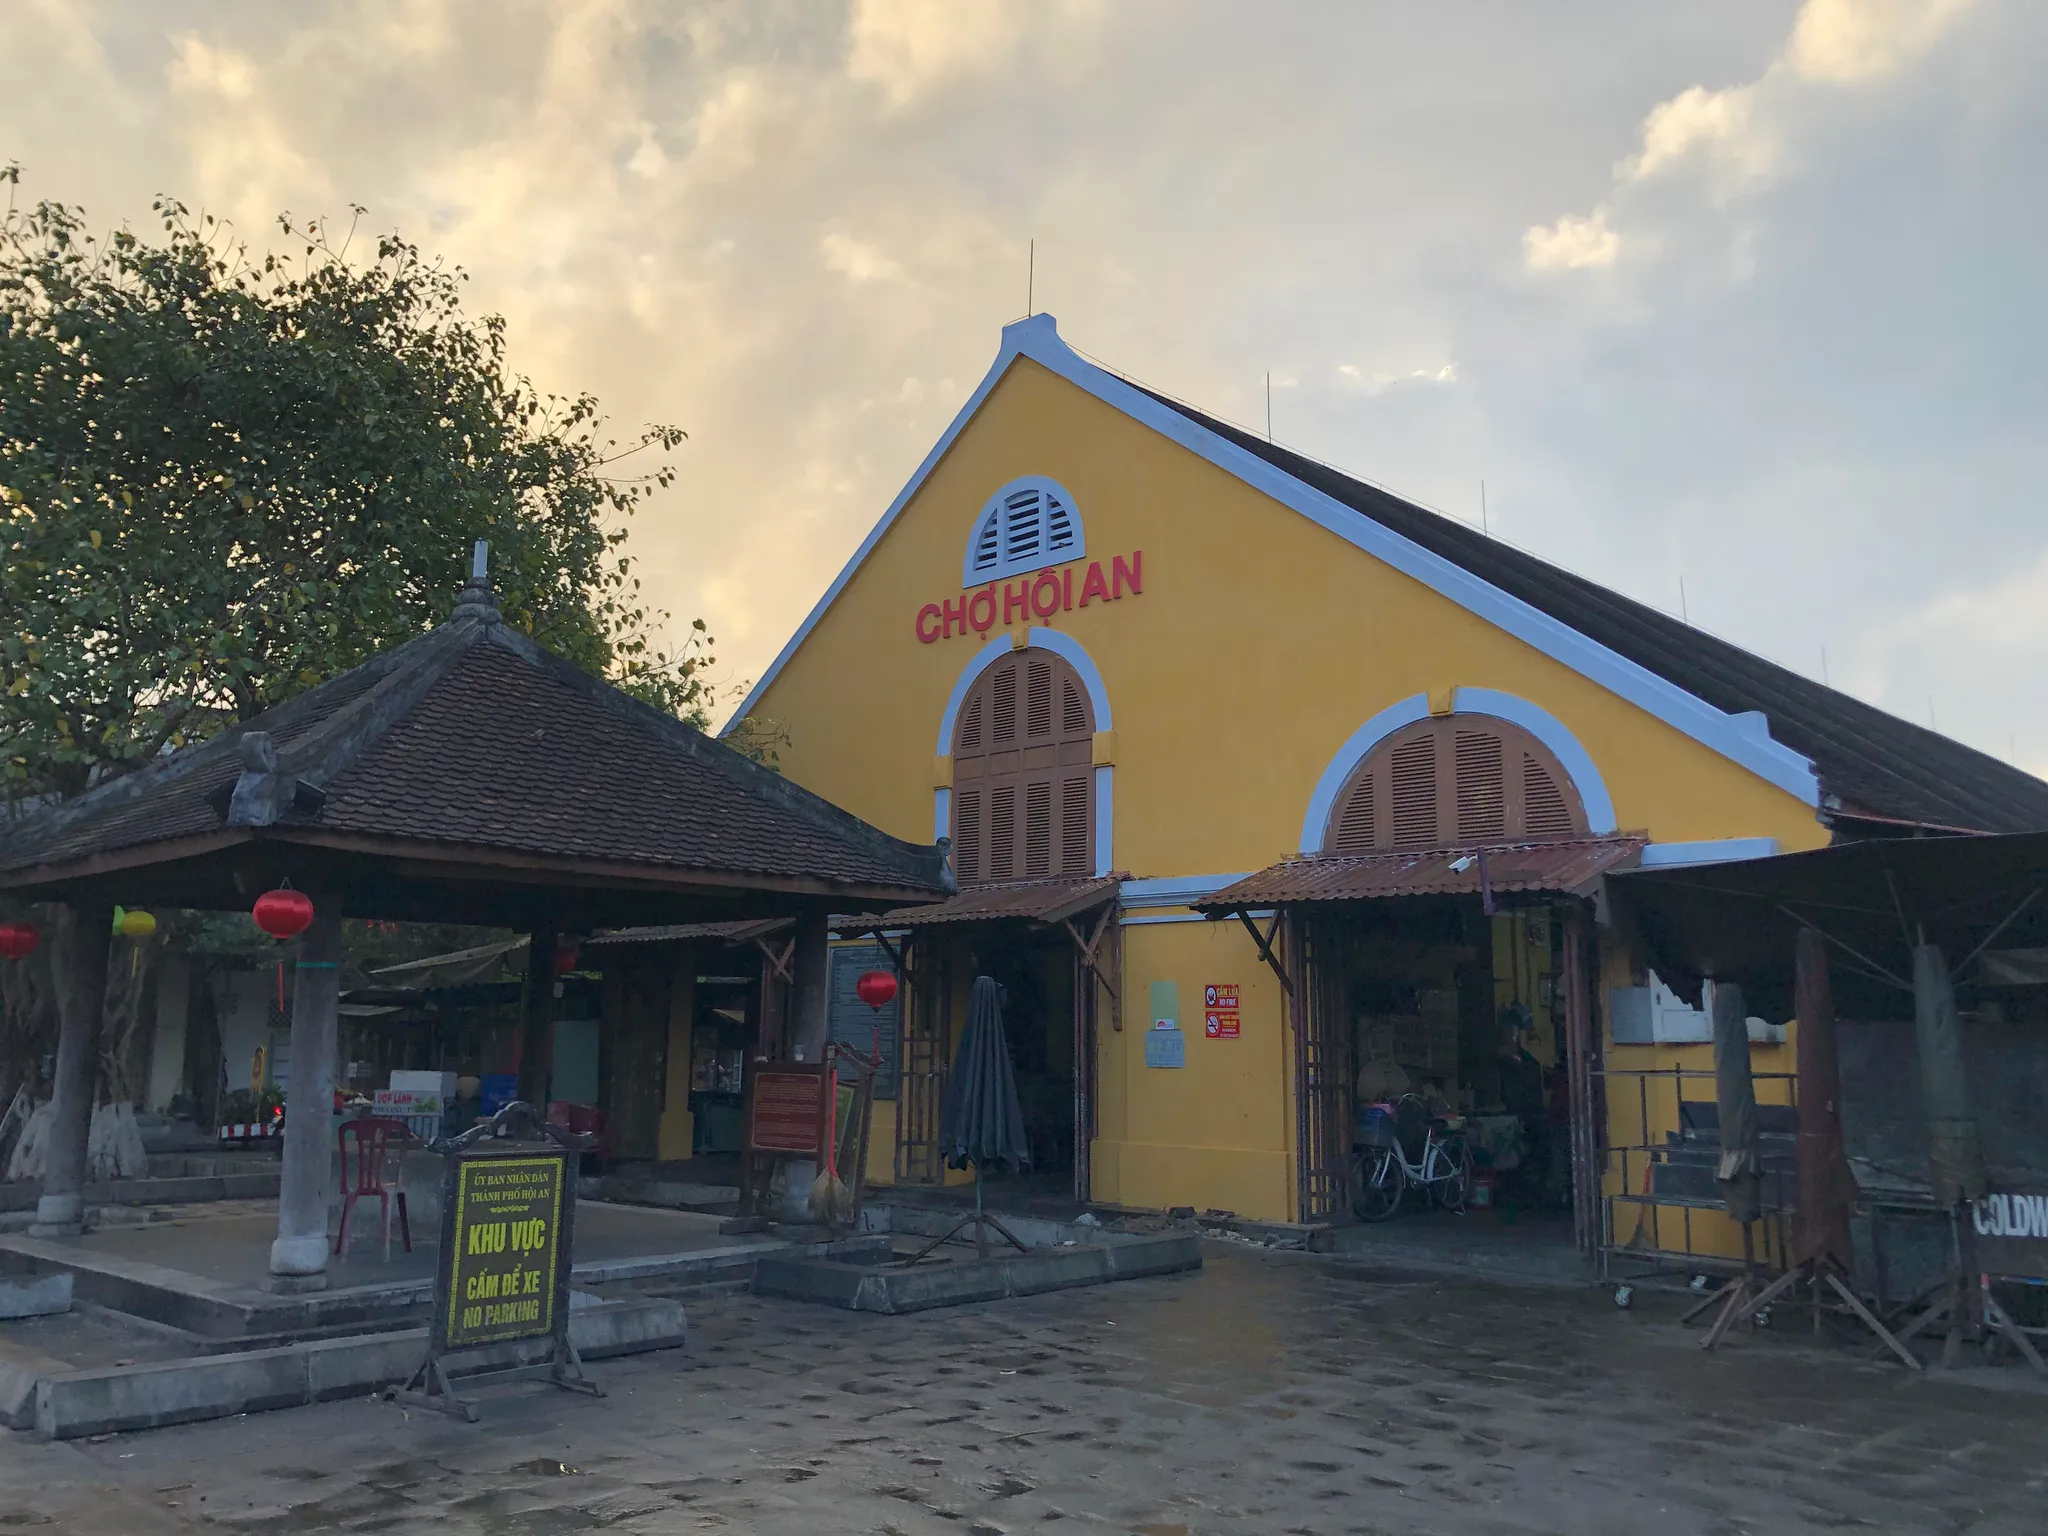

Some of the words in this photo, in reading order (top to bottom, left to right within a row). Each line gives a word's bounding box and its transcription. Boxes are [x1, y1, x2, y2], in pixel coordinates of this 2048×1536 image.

[915, 582, 997, 643] CHỢ
[1003, 566, 1073, 626] HỘI
[1079, 550, 1142, 608] AN
[487, 1174, 507, 1185] BAN
[507, 1171, 532, 1184] NHÂN
[532, 1170, 549, 1183] DÂN
[470, 1189, 500, 1203] THÀNH
[502, 1186, 521, 1201] PHỐ
[521, 1186, 537, 1200] HỘI
[538, 1188, 551, 1199] AN
[468, 1222, 508, 1256] KHU
[511, 1217, 547, 1257] VỰC
[467, 1267, 500, 1300] CẤM
[501, 1263, 522, 1297] ĐỂ
[522, 1270, 541, 1294] XE
[463, 1306, 483, 1329] NO
[484, 1299, 540, 1326] PARKING
